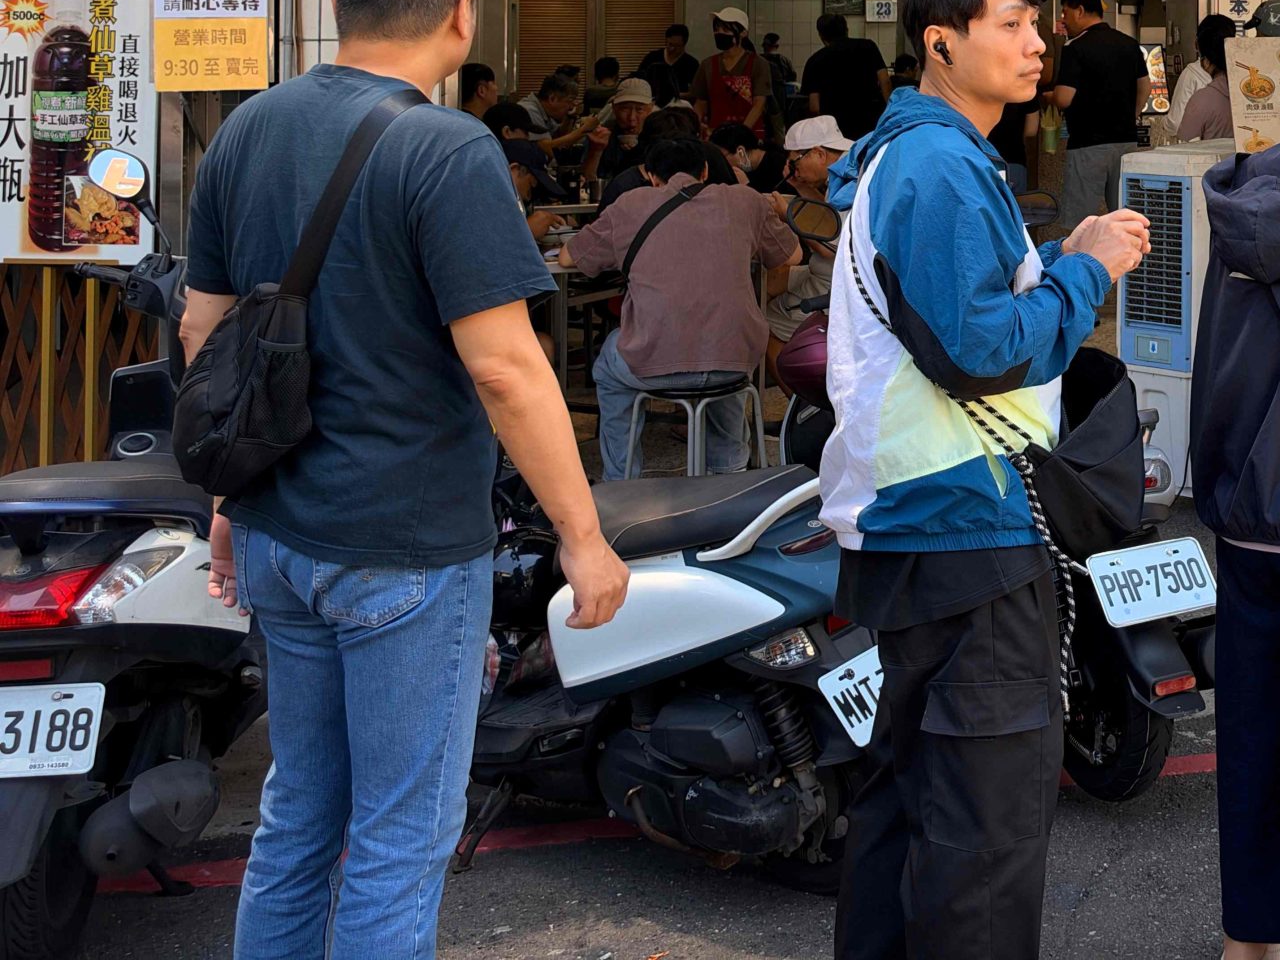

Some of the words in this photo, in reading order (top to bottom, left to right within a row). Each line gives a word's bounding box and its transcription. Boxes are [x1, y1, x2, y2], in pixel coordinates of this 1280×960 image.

[6, 9, 45, 21] 1500cc
[173, 28, 247, 46] 營業時間
[163, 59, 199, 77] 9:30
[204, 59, 221, 77] 至
[226, 56, 260, 76] 賣完
[116, 33, 141, 147] 直接喝退火
[0, 52, 28, 203] 加大瓶
[0, 707, 94, 755] 3188
